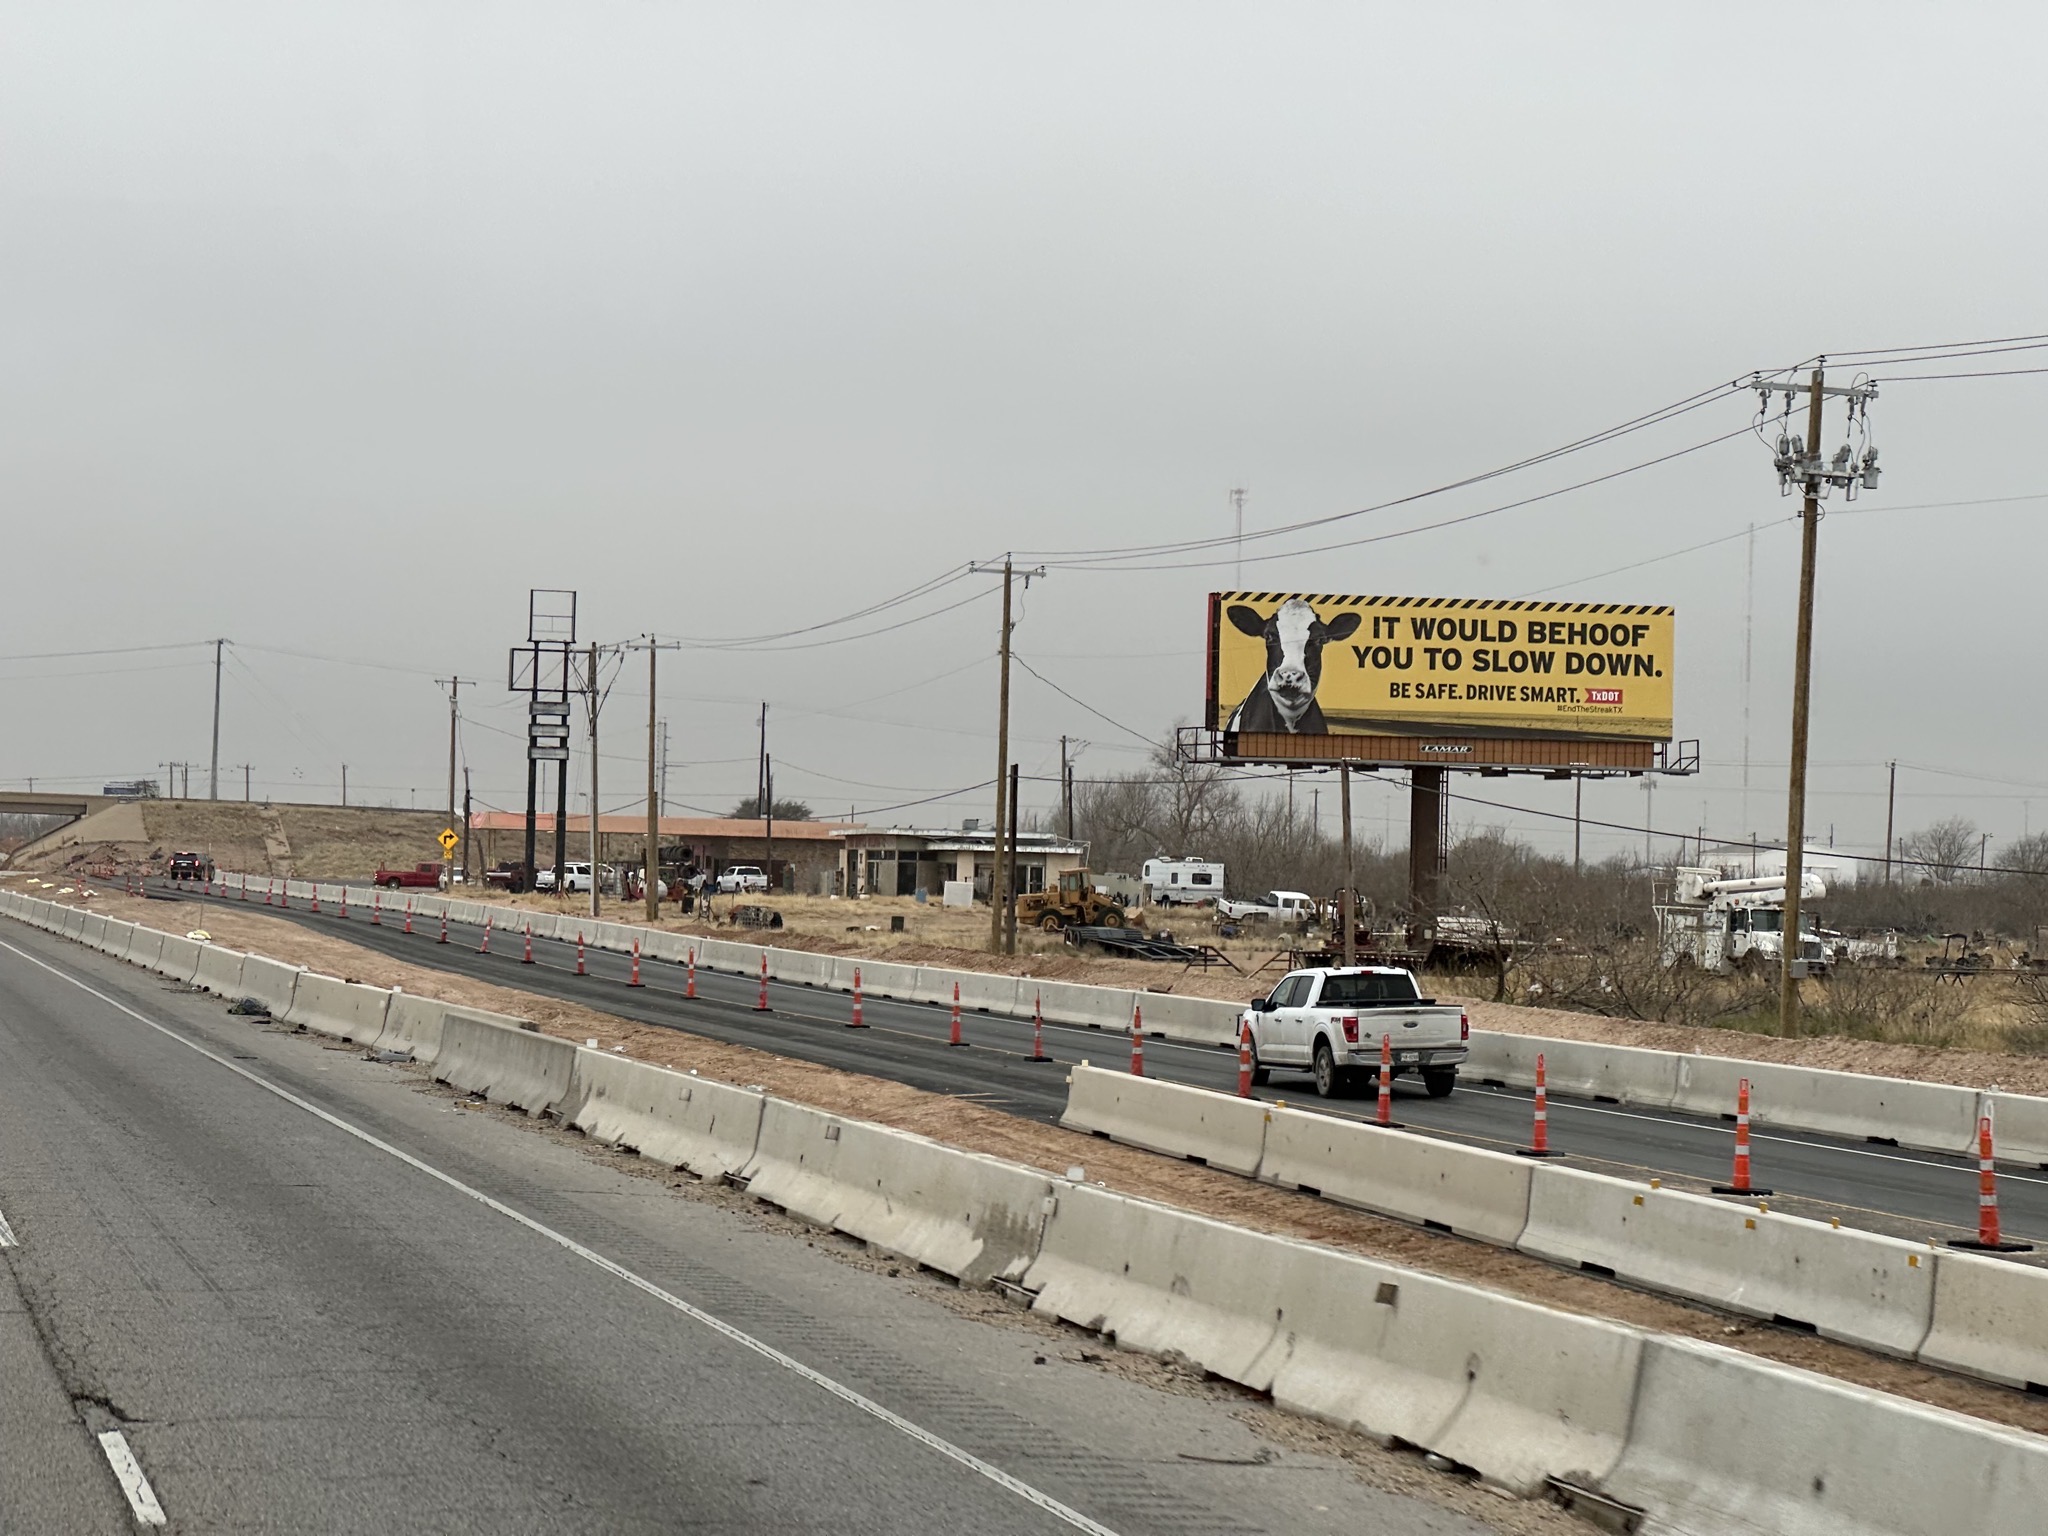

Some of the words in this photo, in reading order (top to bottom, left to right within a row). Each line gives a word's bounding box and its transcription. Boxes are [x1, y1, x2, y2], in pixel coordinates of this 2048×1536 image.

[1372, 616, 1400, 640] IT
[1410, 617, 1517, 643] WOULD
[1528, 621, 1650, 647] BEHOOF
[1351, 645, 1413, 670] YOU
[1423, 647, 1462, 671] TO
[1472, 648, 1555, 674] SLOW
[1565, 652, 1663, 678] DOWN.
[1389, 682, 1411, 699] BE
[1415, 683, 1463, 701] SAFE.
[1466, 684, 1516, 702] DRIVE
[1520, 686, 1581, 704] SMART.
[1591, 691, 1620, 702] TxDOT
[1557, 704, 1623, 714] #EndTheStreakTX
[1424, 745, 1469, 753] LAMAR
